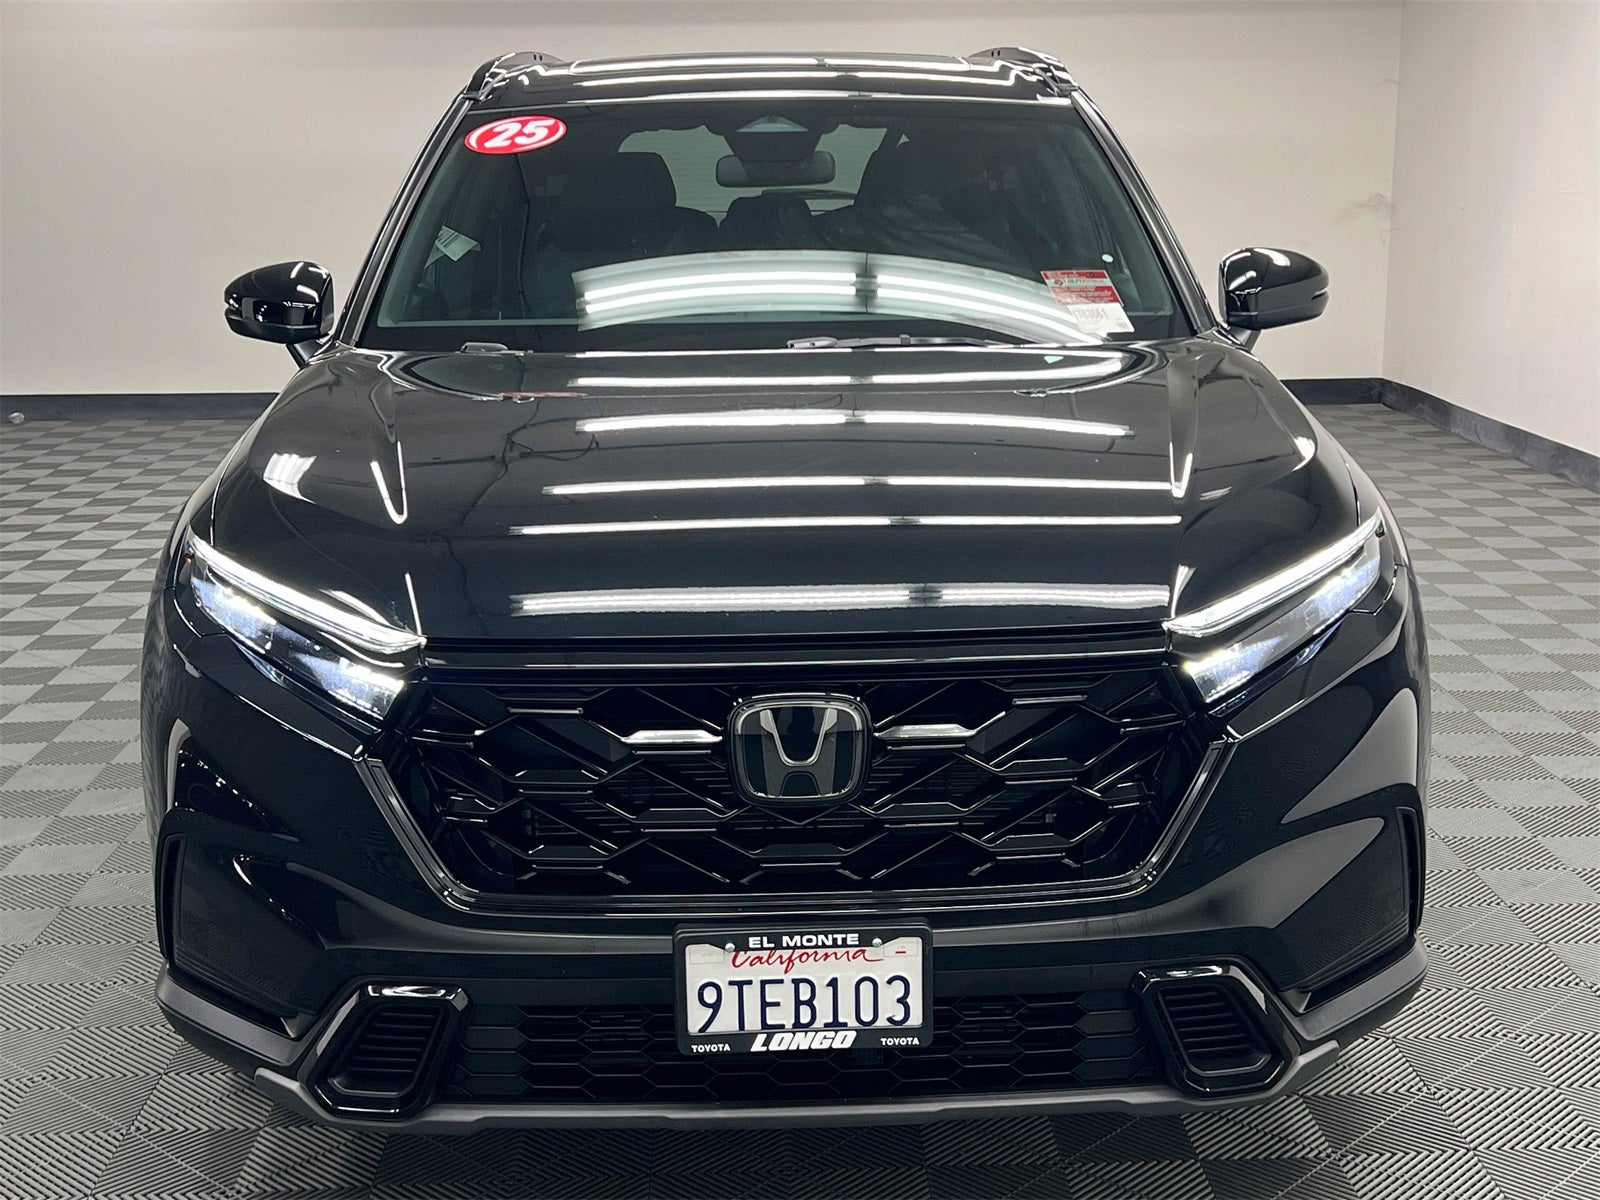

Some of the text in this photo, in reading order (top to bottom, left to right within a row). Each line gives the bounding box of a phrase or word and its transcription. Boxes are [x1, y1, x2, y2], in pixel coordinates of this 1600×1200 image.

[483, 120, 555, 149] 25
[748, 933, 860, 948] EL MONTE
[731, 949, 884, 974] California
[697, 975, 911, 1033] 9TEB103
[691, 1043, 731, 1053] TOYOTA
[750, 1030, 858, 1052] LONGO
[880, 1037, 920, 1046] TOYOTA
